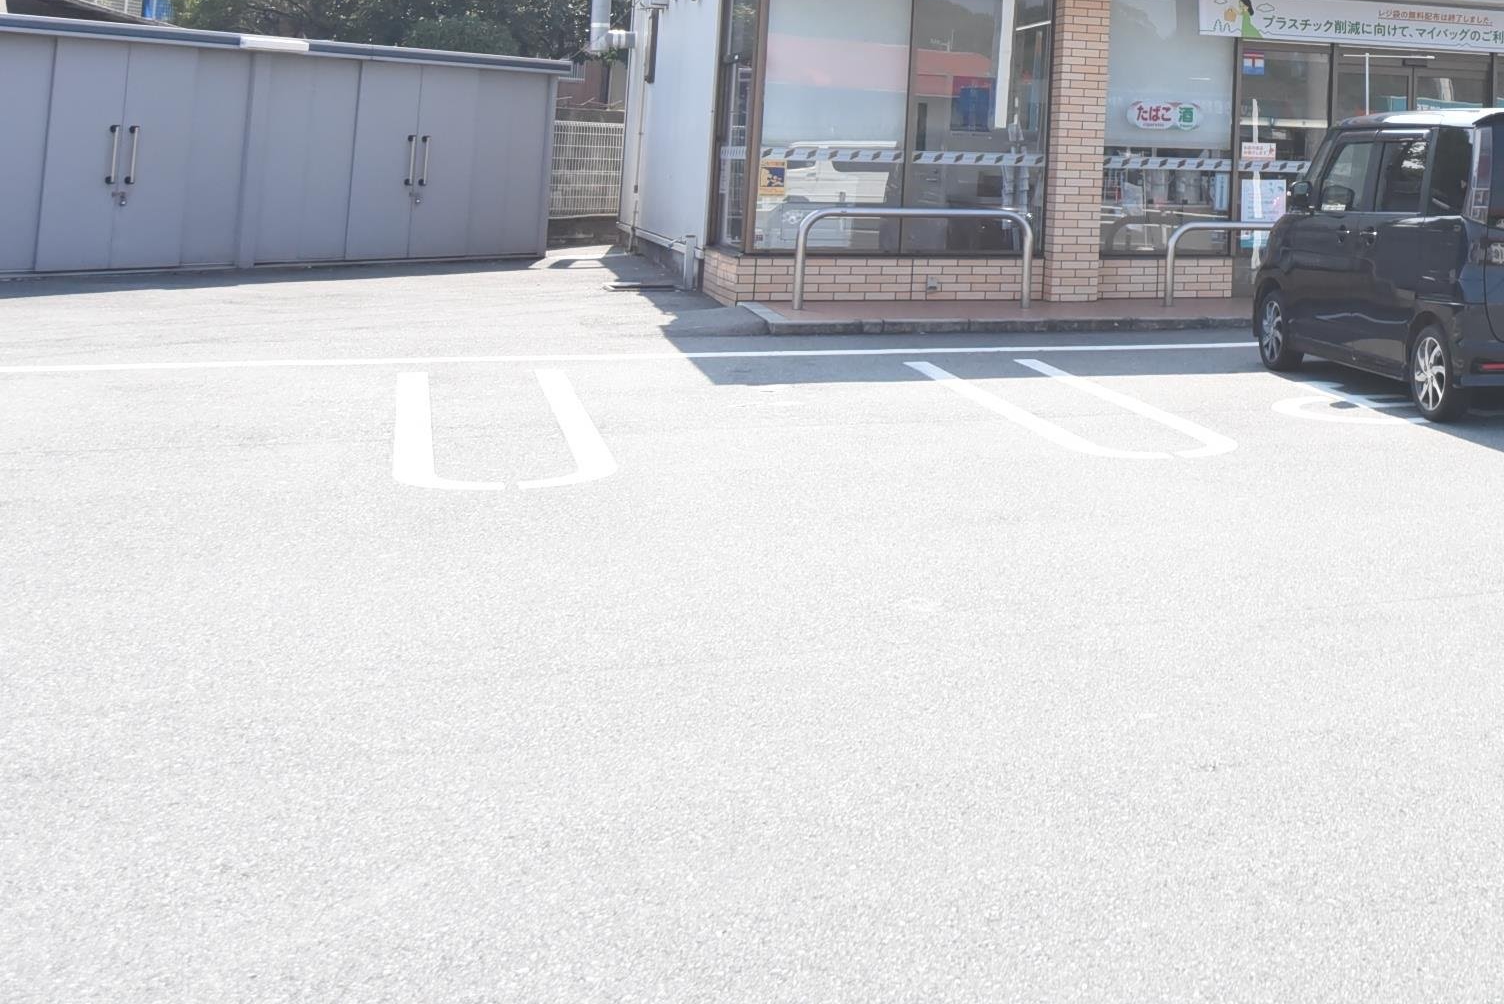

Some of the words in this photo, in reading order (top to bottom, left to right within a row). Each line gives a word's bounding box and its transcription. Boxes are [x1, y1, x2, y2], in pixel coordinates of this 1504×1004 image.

[1136, 105, 1172, 122] たばこ
[1178, 106, 1194, 123] 酒
